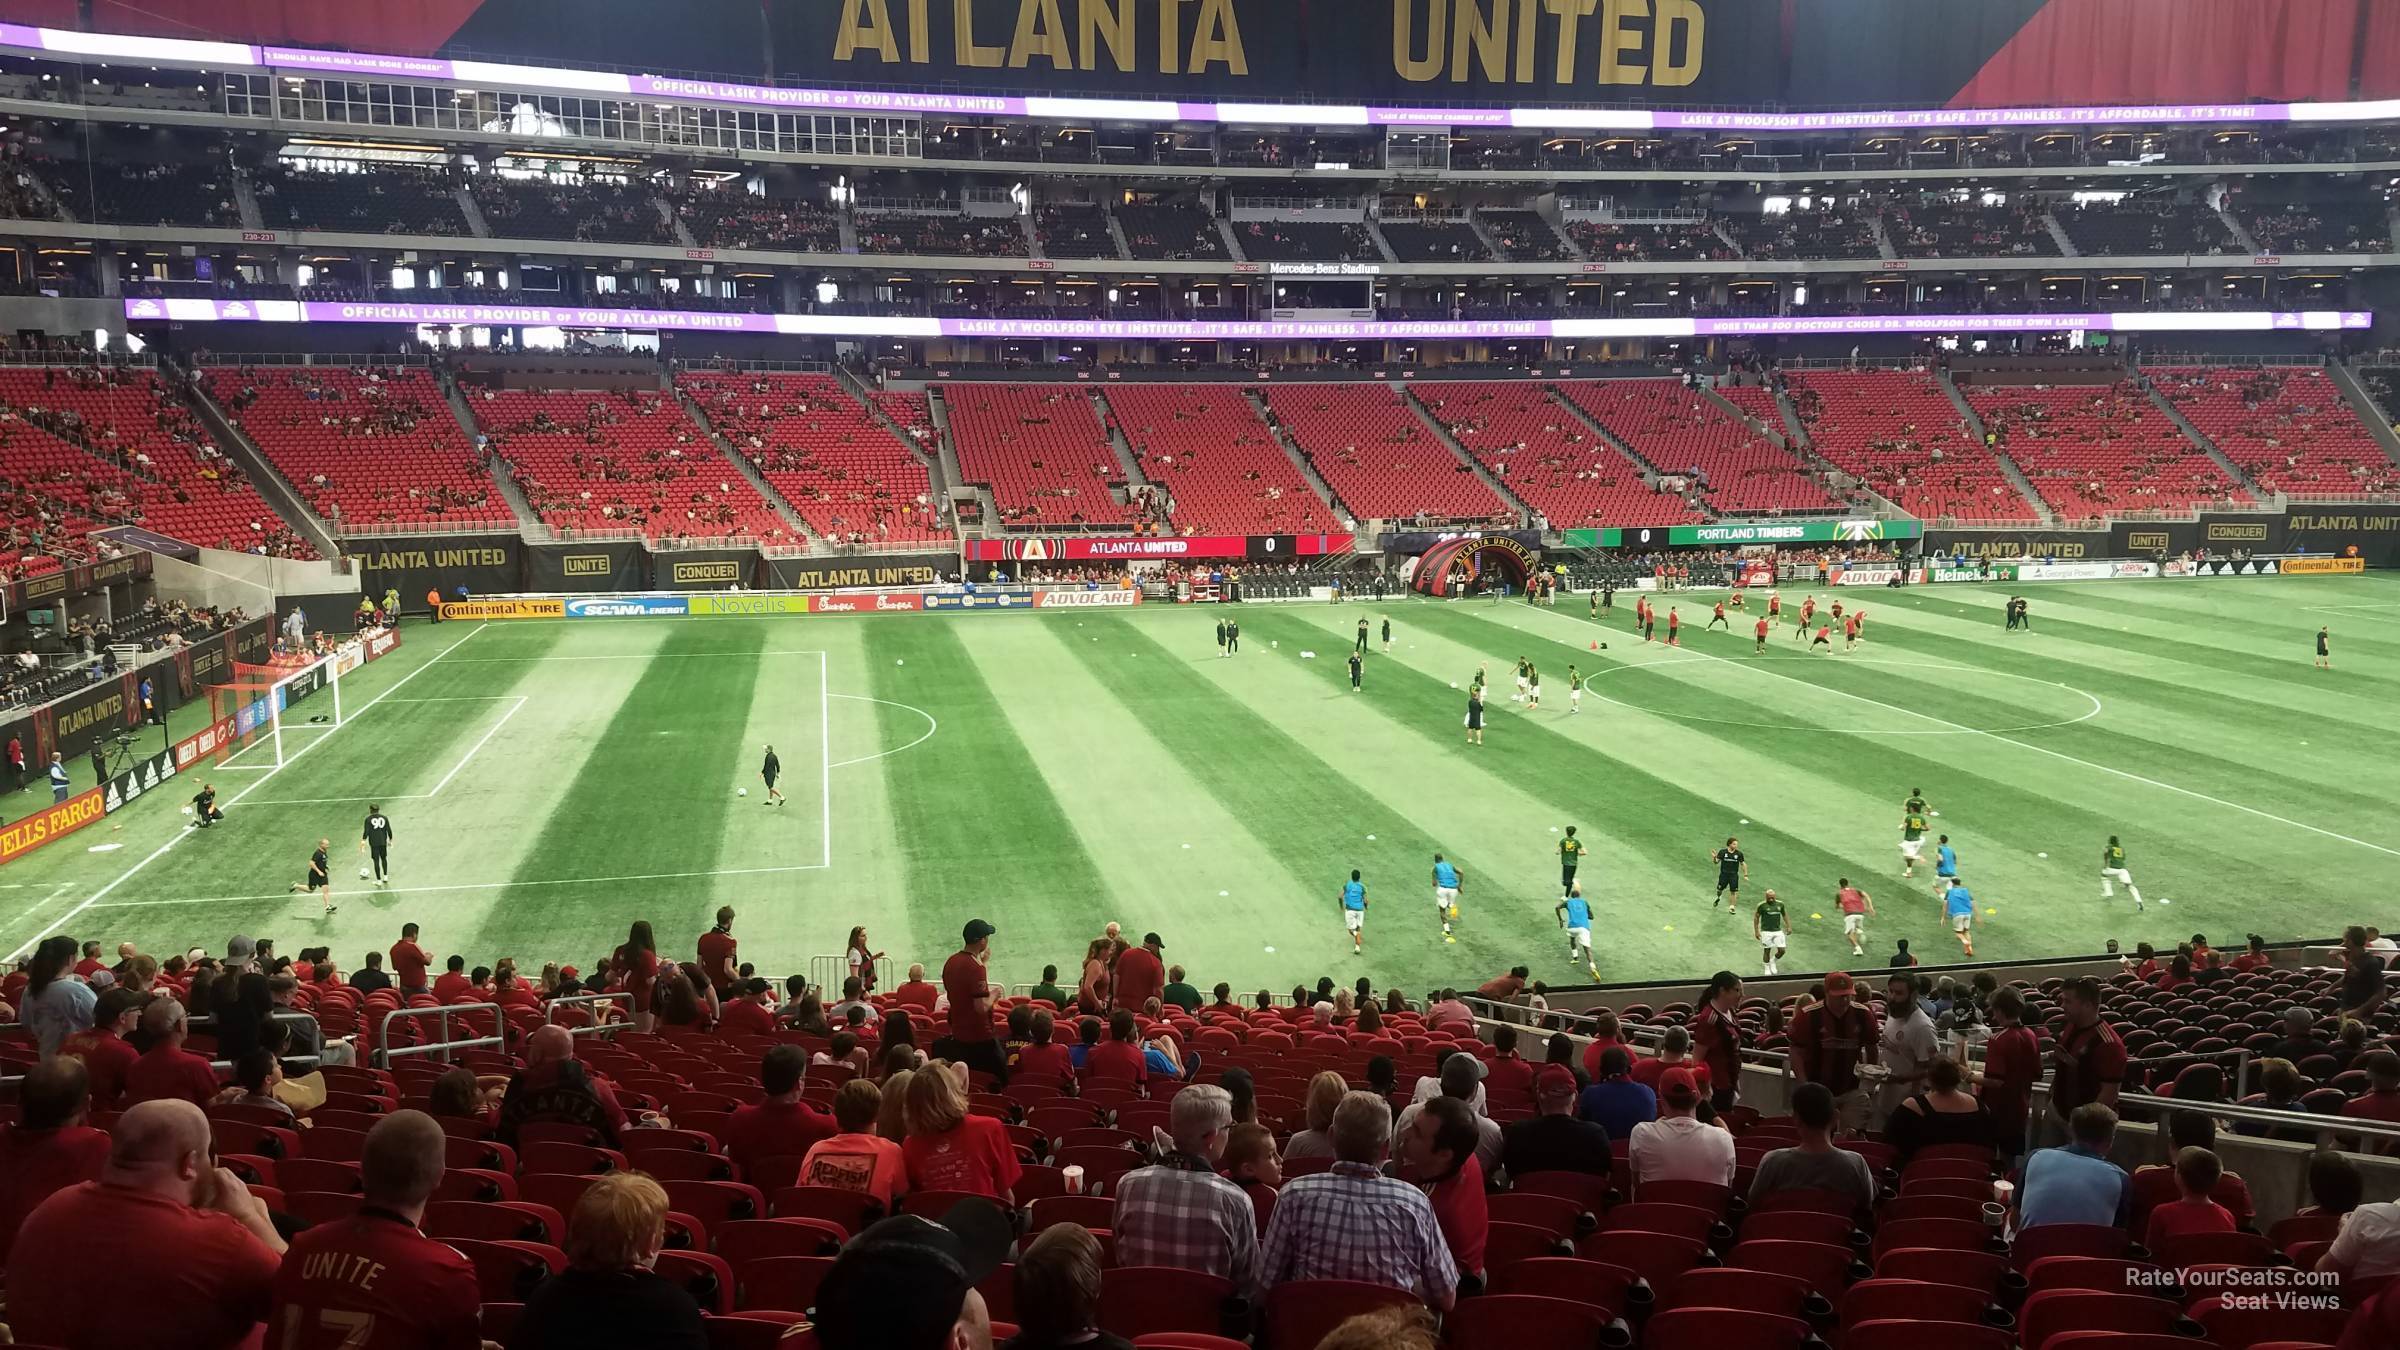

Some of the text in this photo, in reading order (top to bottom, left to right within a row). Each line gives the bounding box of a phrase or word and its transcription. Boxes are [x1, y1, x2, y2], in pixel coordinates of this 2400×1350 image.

[833, 0, 1703, 86] ATLANTA UNITED
[270, 53, 308, 63] SHOULD
[309, 55, 332, 65] HAVE
[652, 80, 715, 97] OFFICIAL
[719, 86, 756, 99] LASIK
[762, 88, 830, 104] PROVIDER
[852, 93, 890, 107] YOUR
[895, 95, 953, 109] ATLANTA
[957, 97, 1006, 111] UNITED
[1681, 115, 1713, 126] LASIK
[1716, 116, 1732, 126] AT
[1734, 116, 1799, 127] WOOLFSON
[1803, 115, 1826, 126] EYE
[1935, 113, 1971, 124] SAFE.
[1976, 111, 1999, 122] IT'S
[2003, 110, 2067, 122] PAINLESS.
[2071, 109, 2094, 121] IT'S
[2097, 108, 2186, 121] AFFORDABLE.
[2191, 108, 2215, 119] IT'S
[2219, 107, 2256, 118] TIME!
[244, 232, 274, 241] 230-231
[1269, 262, 1380, 274] Mercedes-Benz Stadium
[342, 307, 417, 320] OFFICIAL
[424, 309, 466, 321] LASIK
[473, 309, 550, 323] PROVIDER
[578, 312, 618, 325] YOUR
[622, 313, 687, 326] ATLANTA
[691, 316, 743, 328] UNITED
[1713, 322, 1741, 331] MORE
[1743, 322, 1769, 331] THAN
[1795, 321, 1844, 330] DOCTORS
[1846, 321, 1881, 330] CHOSE
[1884, 321, 1903, 329] DR.
[1906, 320, 1965, 329] WOOLFSON
[1968, 320, 1989, 328] FOR
[1992, 319, 2023, 328] THEIR
[2027, 319, 2051, 328] OWN
[2056, 318, 2089, 327] LASIK!
[959, 322, 996, 333] LASIK
[1003, 322, 1018, 333] AT
[1021, 322, 1094, 334] WOOLFSON
[1101, 323, 1123, 334] EYE
[1232, 324, 1267, 335] SAFE.
[1272, 324, 1294, 335] IT'S
[1299, 324, 1360, 335] PAINLESS.
[1364, 324, 1386, 335] IT'S
[1390, 323, 1472, 334] AFFORDABLE.
[1476, 323, 1499, 334] IT'S
[1503, 323, 1536, 333] TIME!
[2288, 516, 2400, 531] ATLANTA UNIT
[1640, 528, 1651, 543] 0
[1697, 527, 1805, 540] PORTLAND TIMBERS
[2211, 526, 2263, 537] CONQUER
[1089, 541, 1188, 554] ATLANTA UNITED
[1265, 537, 1276, 552] 0
[2132, 535, 2166, 546] UNITE
[1455, 538, 1489, 564] ATLANTA
[1493, 537, 1523, 554] UNITED
[1951, 542, 2084, 558] ATLANTA UNITED
[352, 549, 506, 571] TLANTA UNITED
[568, 559, 607, 572] UNITE
[2283, 560, 2332, 573] Continental
[2343, 561, 2361, 569] TIRE
[678, 565, 735, 579] CONQUER
[799, 569, 871, 588] ATLANTA
[1841, 570, 1920, 584] ADVOCAE
[1934, 569, 1998, 582] Heinekn
[1044, 590, 1133, 605] ADVOCARE
[442, 603, 560, 618] Continental TIRE
[583, 604, 686, 616] SCANA ENERGY
[711, 598, 787, 613] Novelis
[58, 693, 123, 737] ATLANTA UNITED
[0, 793, 103, 857] ELLS FARGO
[370, 817, 386, 829] 90
[302, 1252, 386, 1290] UNITE
